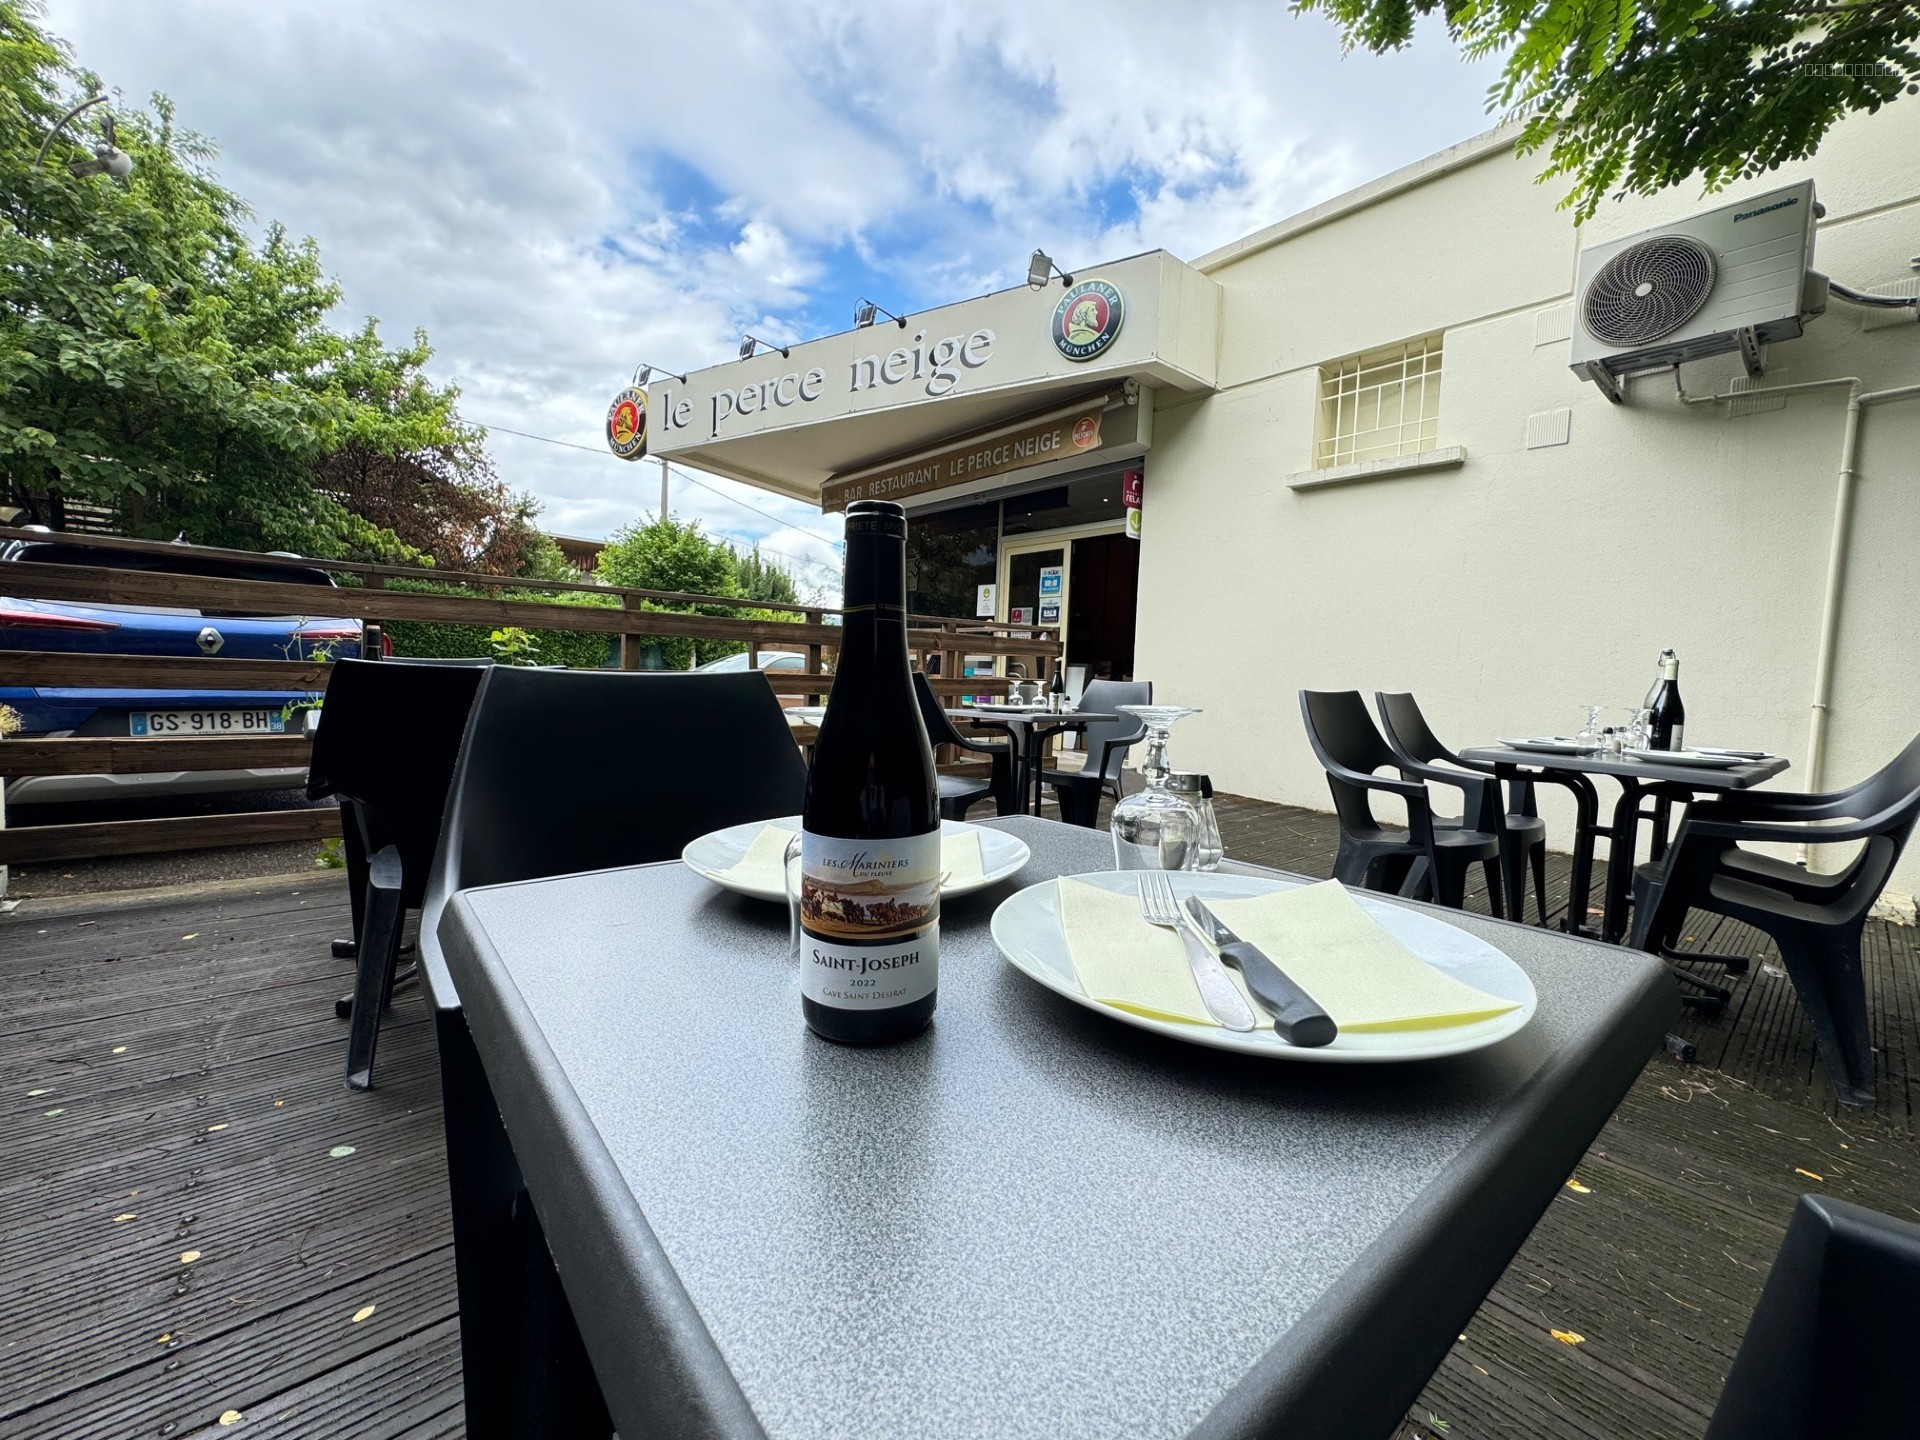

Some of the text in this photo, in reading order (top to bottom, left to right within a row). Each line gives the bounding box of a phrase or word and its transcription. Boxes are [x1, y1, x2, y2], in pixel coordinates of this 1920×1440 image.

[1733, 197, 1799, 223] Panasonic
[1056, 281, 1119, 316] PAULANER
[662, 327, 997, 438] le perce neige
[607, 390, 646, 422] PAULANER
[843, 429, 1062, 501] BAR RESTAURANT LE PERCE NEIGE
[150, 711, 268, 732] GS-918-BH
[270, 722, 282, 731] 38
[822, 851, 909, 878] LES MARINIERS
[850, 979, 877, 987] 2022
